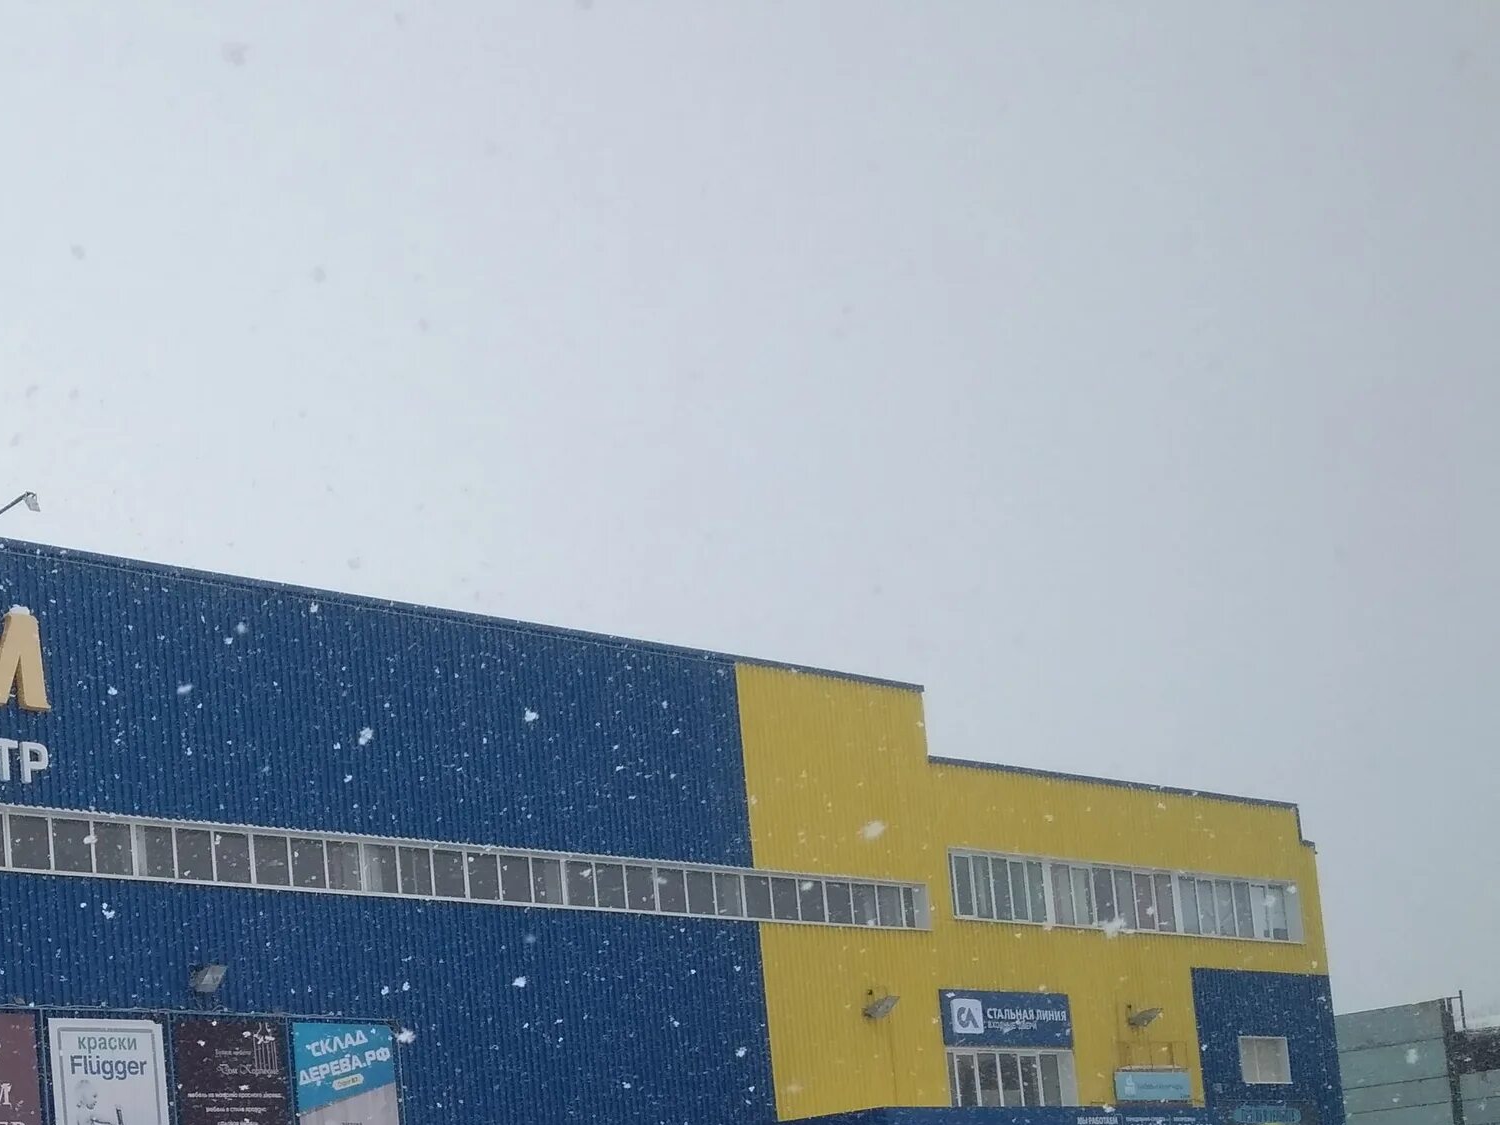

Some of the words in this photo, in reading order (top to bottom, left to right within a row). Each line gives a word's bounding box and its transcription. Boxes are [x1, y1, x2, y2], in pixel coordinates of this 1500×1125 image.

[987, 1008, 1034, 1021] СТАЛЬНАЯ
[1036, 1010, 1066, 1021] ЛИНИЯ
[78, 1036, 137, 1054] краски
[310, 1030, 368, 1058] СКЛАД
[70, 1055, 147, 1080] Flügger
[300, 1047, 390, 1086] ДЕРЕВА.РФ
